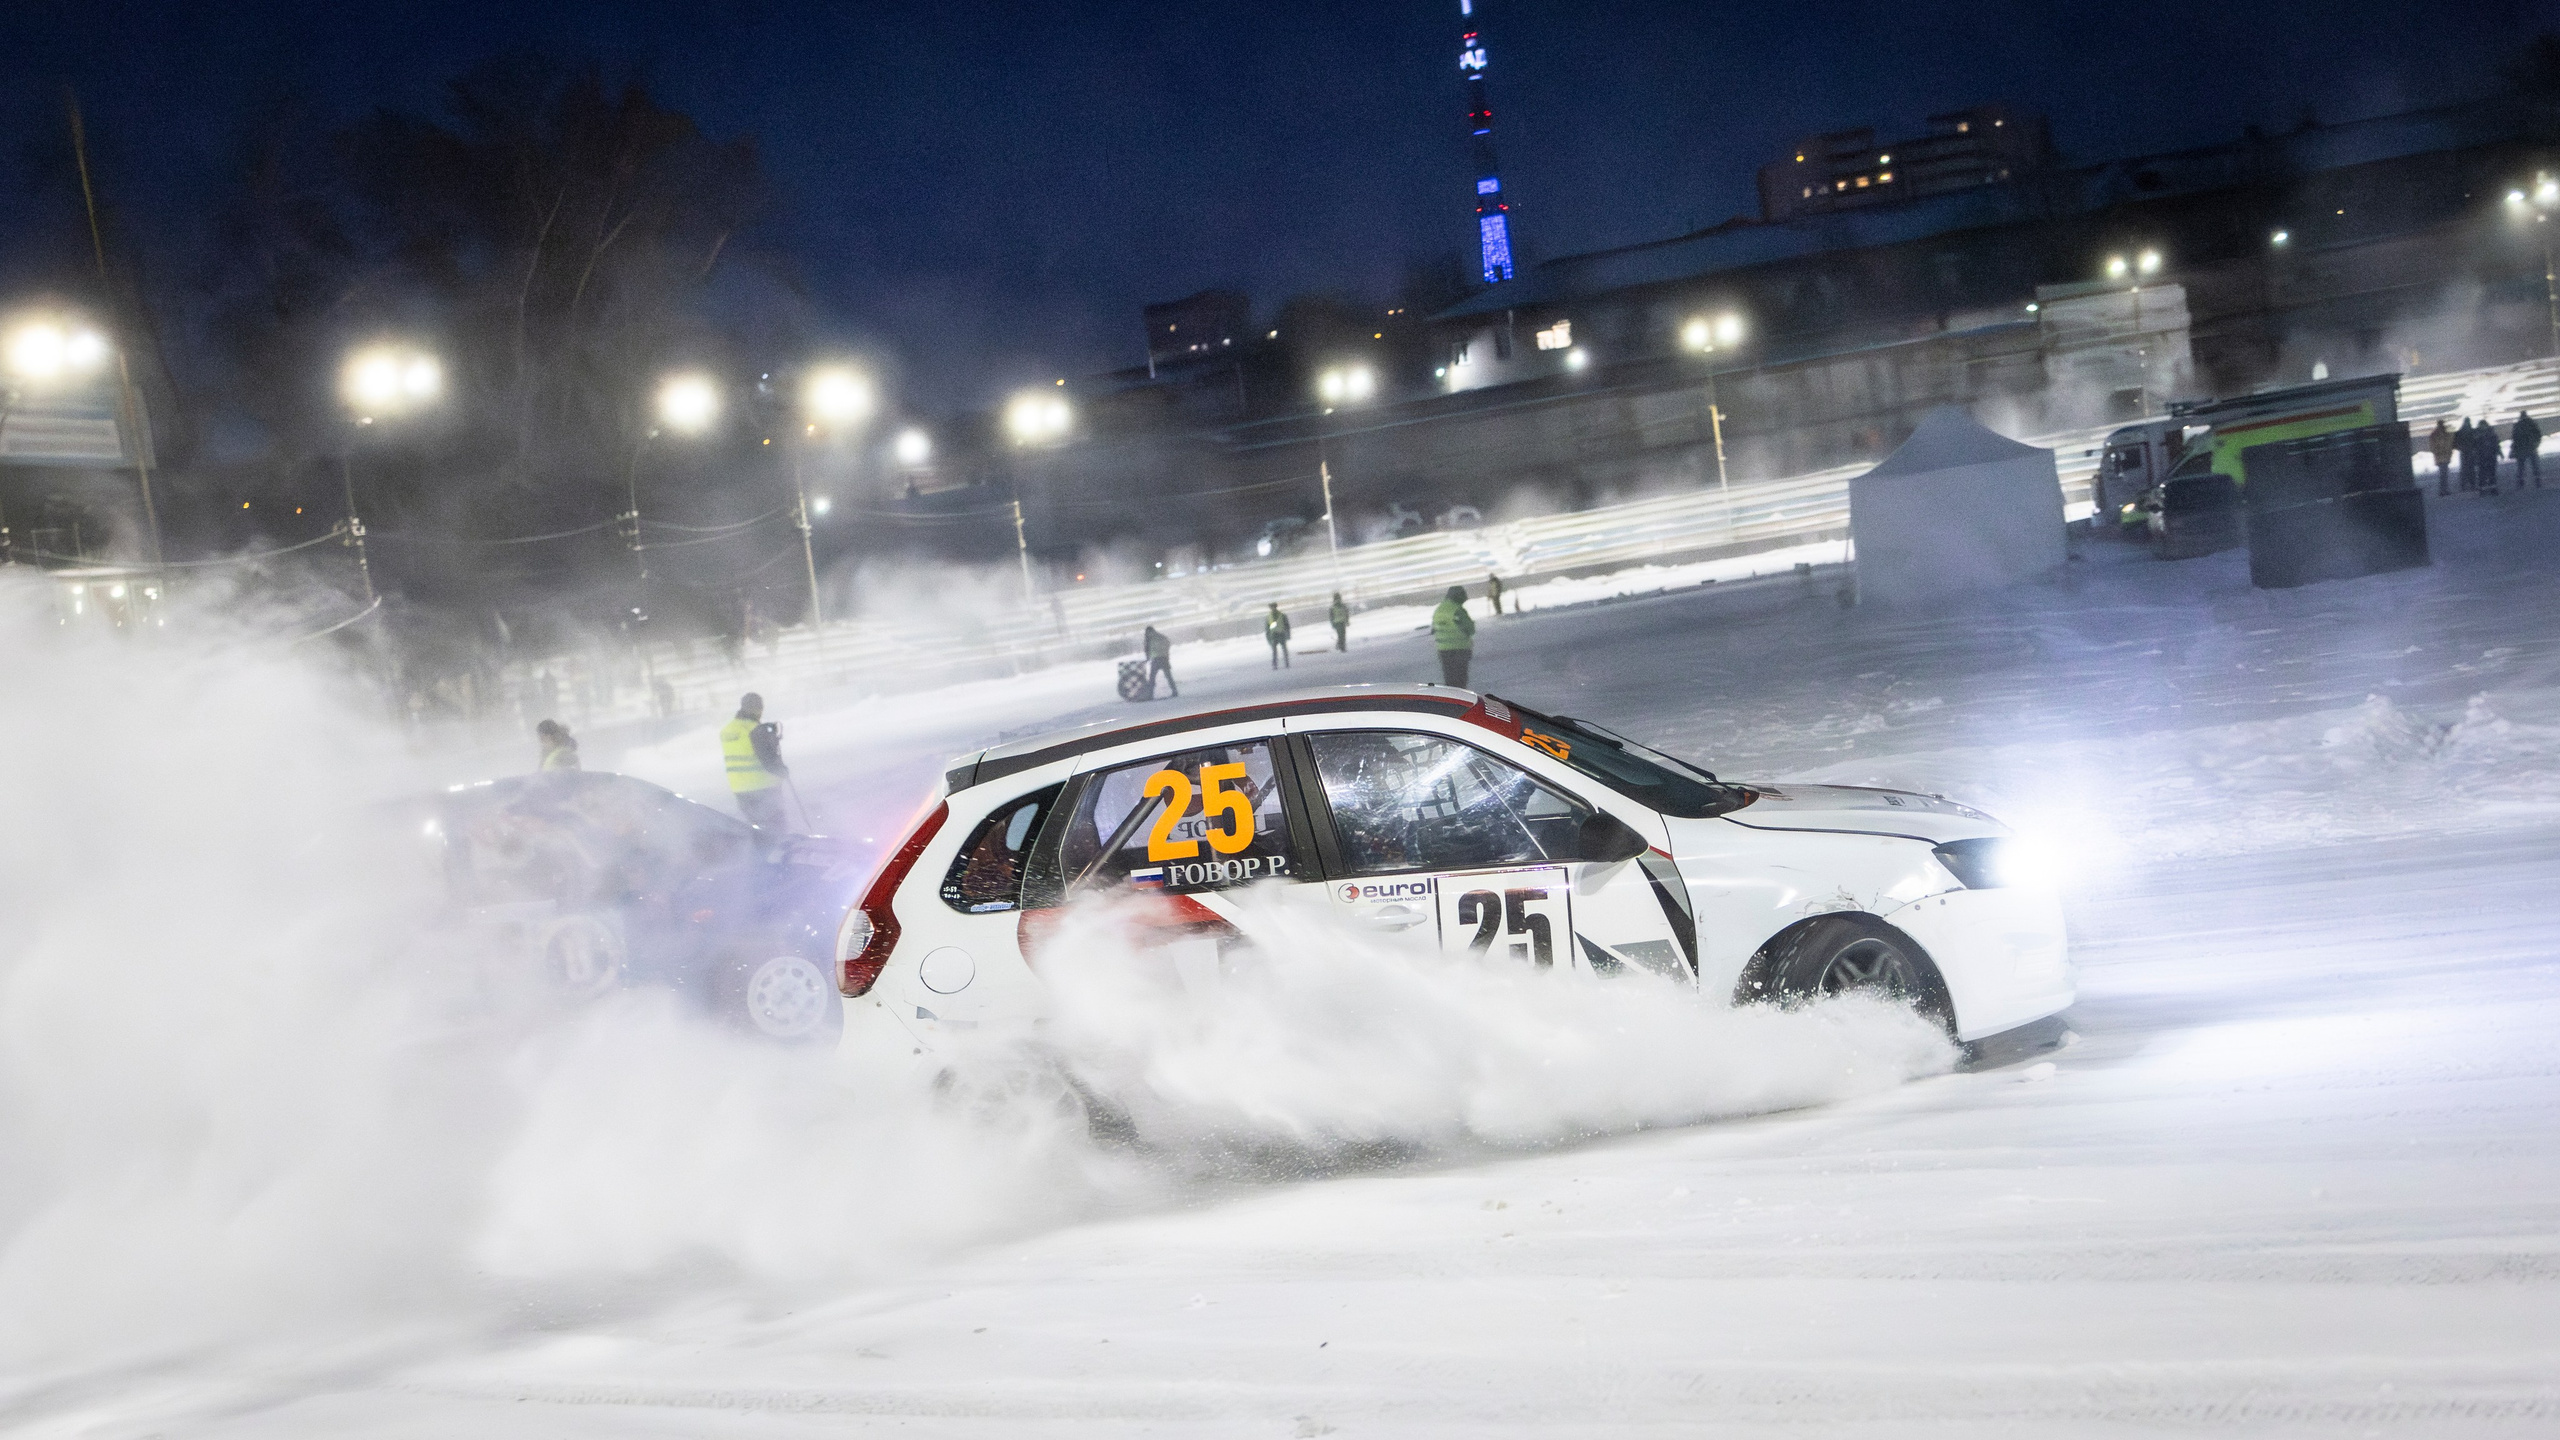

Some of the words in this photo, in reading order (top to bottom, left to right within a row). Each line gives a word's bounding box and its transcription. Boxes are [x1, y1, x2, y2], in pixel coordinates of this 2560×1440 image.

[1521, 728, 1571, 760] 25
[1143, 762, 1254, 862] 25
[1168, 857, 1260, 887] ГОВОР
[1266, 855, 1291, 876] Р.
[1362, 878, 1432, 898] eurol
[1458, 888, 1554, 966] 25
